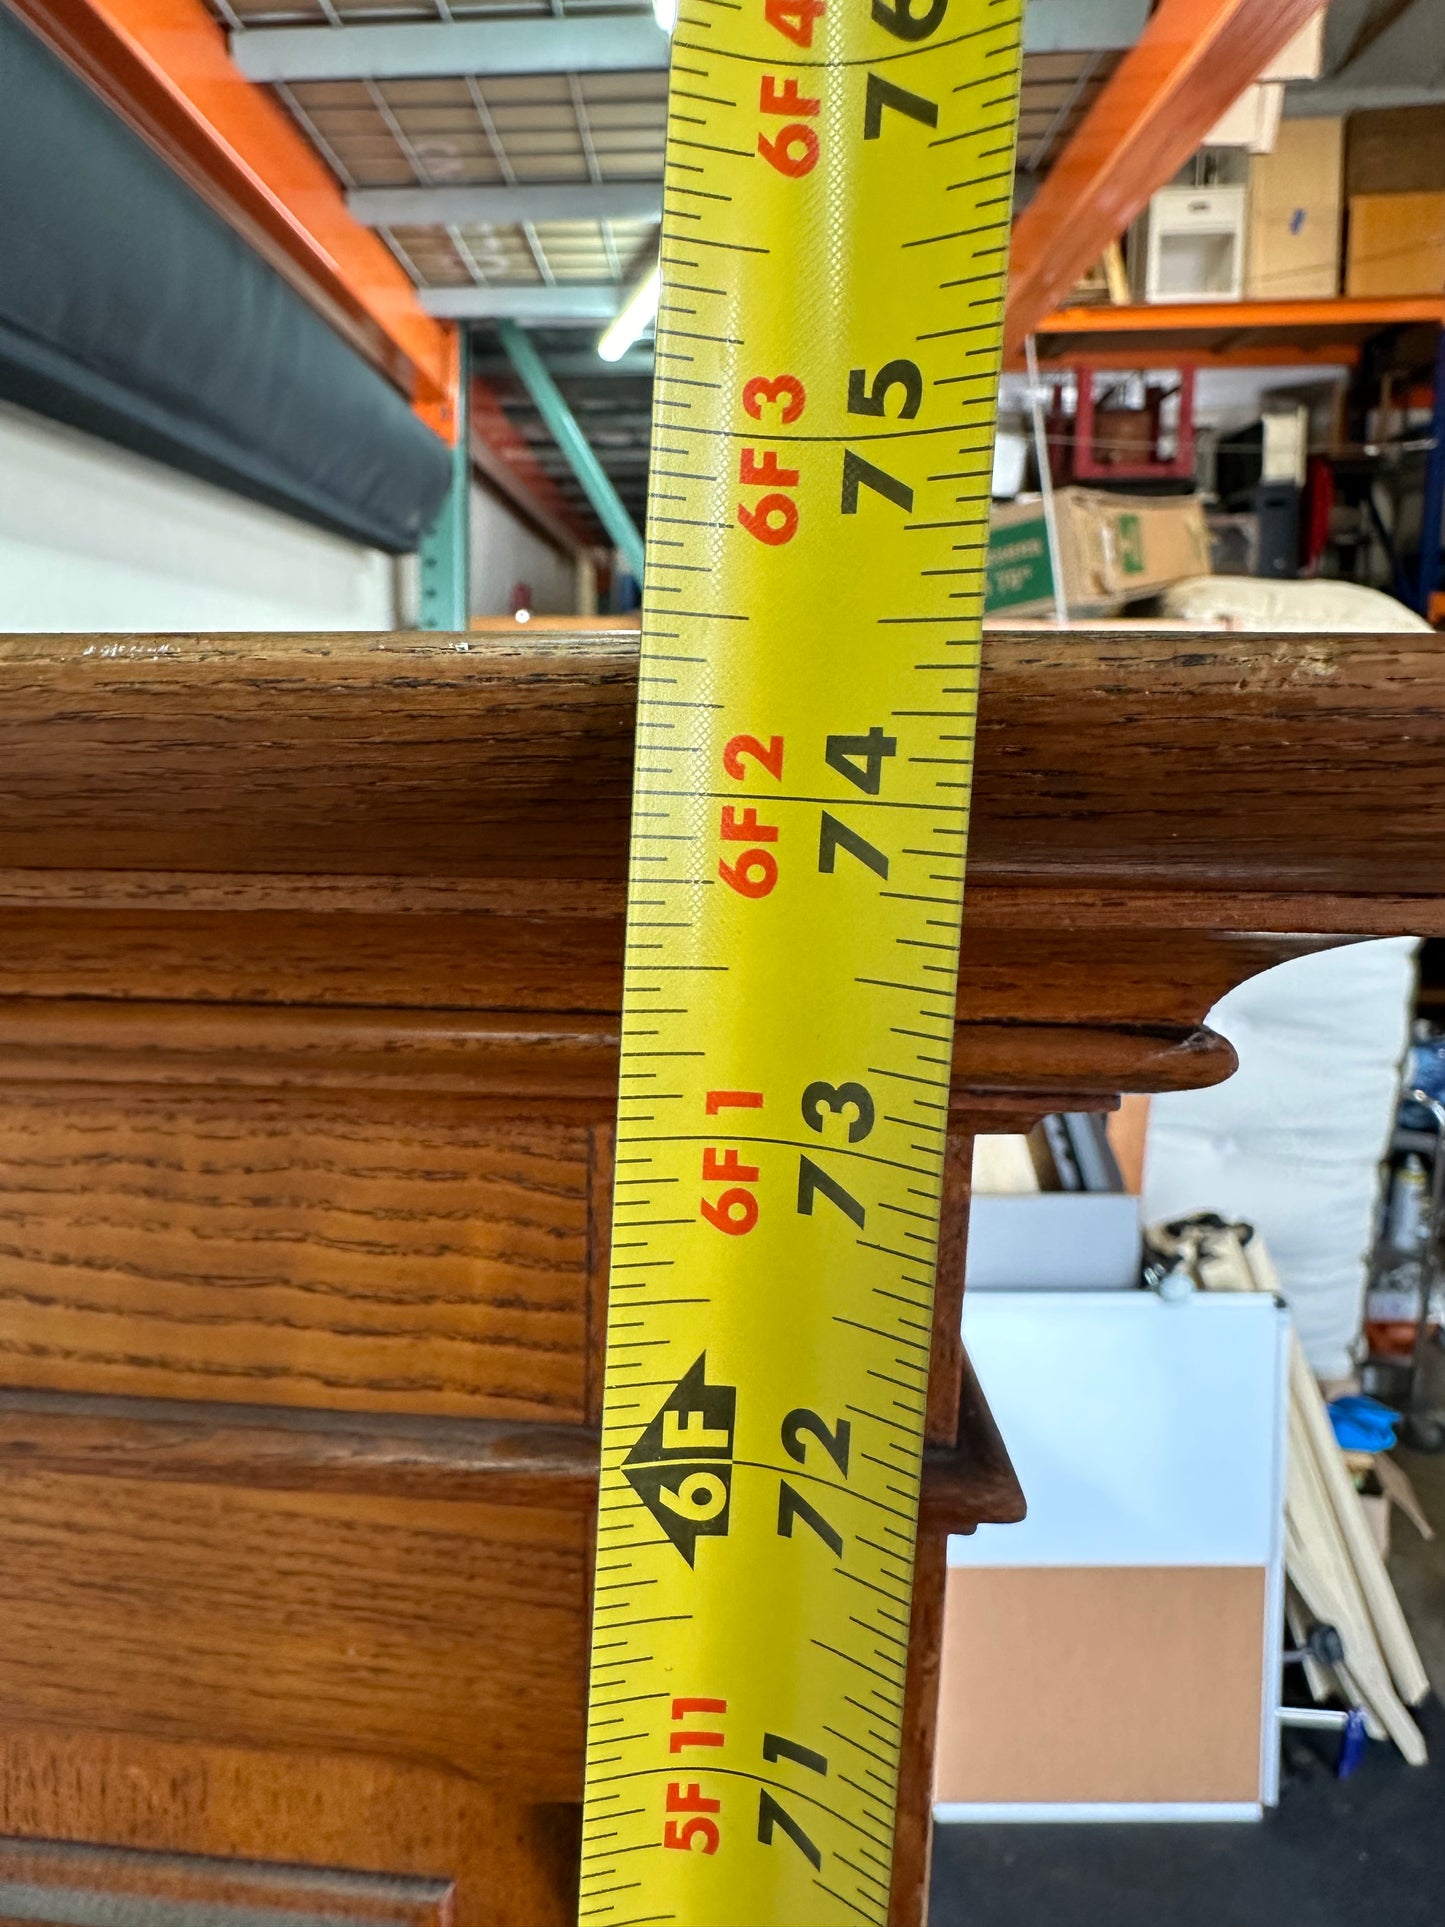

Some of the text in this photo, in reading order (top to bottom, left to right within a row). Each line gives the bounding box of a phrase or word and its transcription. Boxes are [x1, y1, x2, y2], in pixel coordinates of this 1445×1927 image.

[760, 0, 825, 177] 6F 4
[738, 374, 806, 546] 6F 3
[841, 360, 923, 514] 75
[719, 734, 784, 899] 6F 2
[818, 727, 897, 880] 74
[701, 1090, 764, 1236] 6F 1
[797, 1081, 874, 1230] 73
[659, 1408, 731, 1522] 6F
[778, 1408, 851, 1558] 72
[664, 1697, 727, 1855] 5F 11
[757, 1733, 828, 1872] 71
